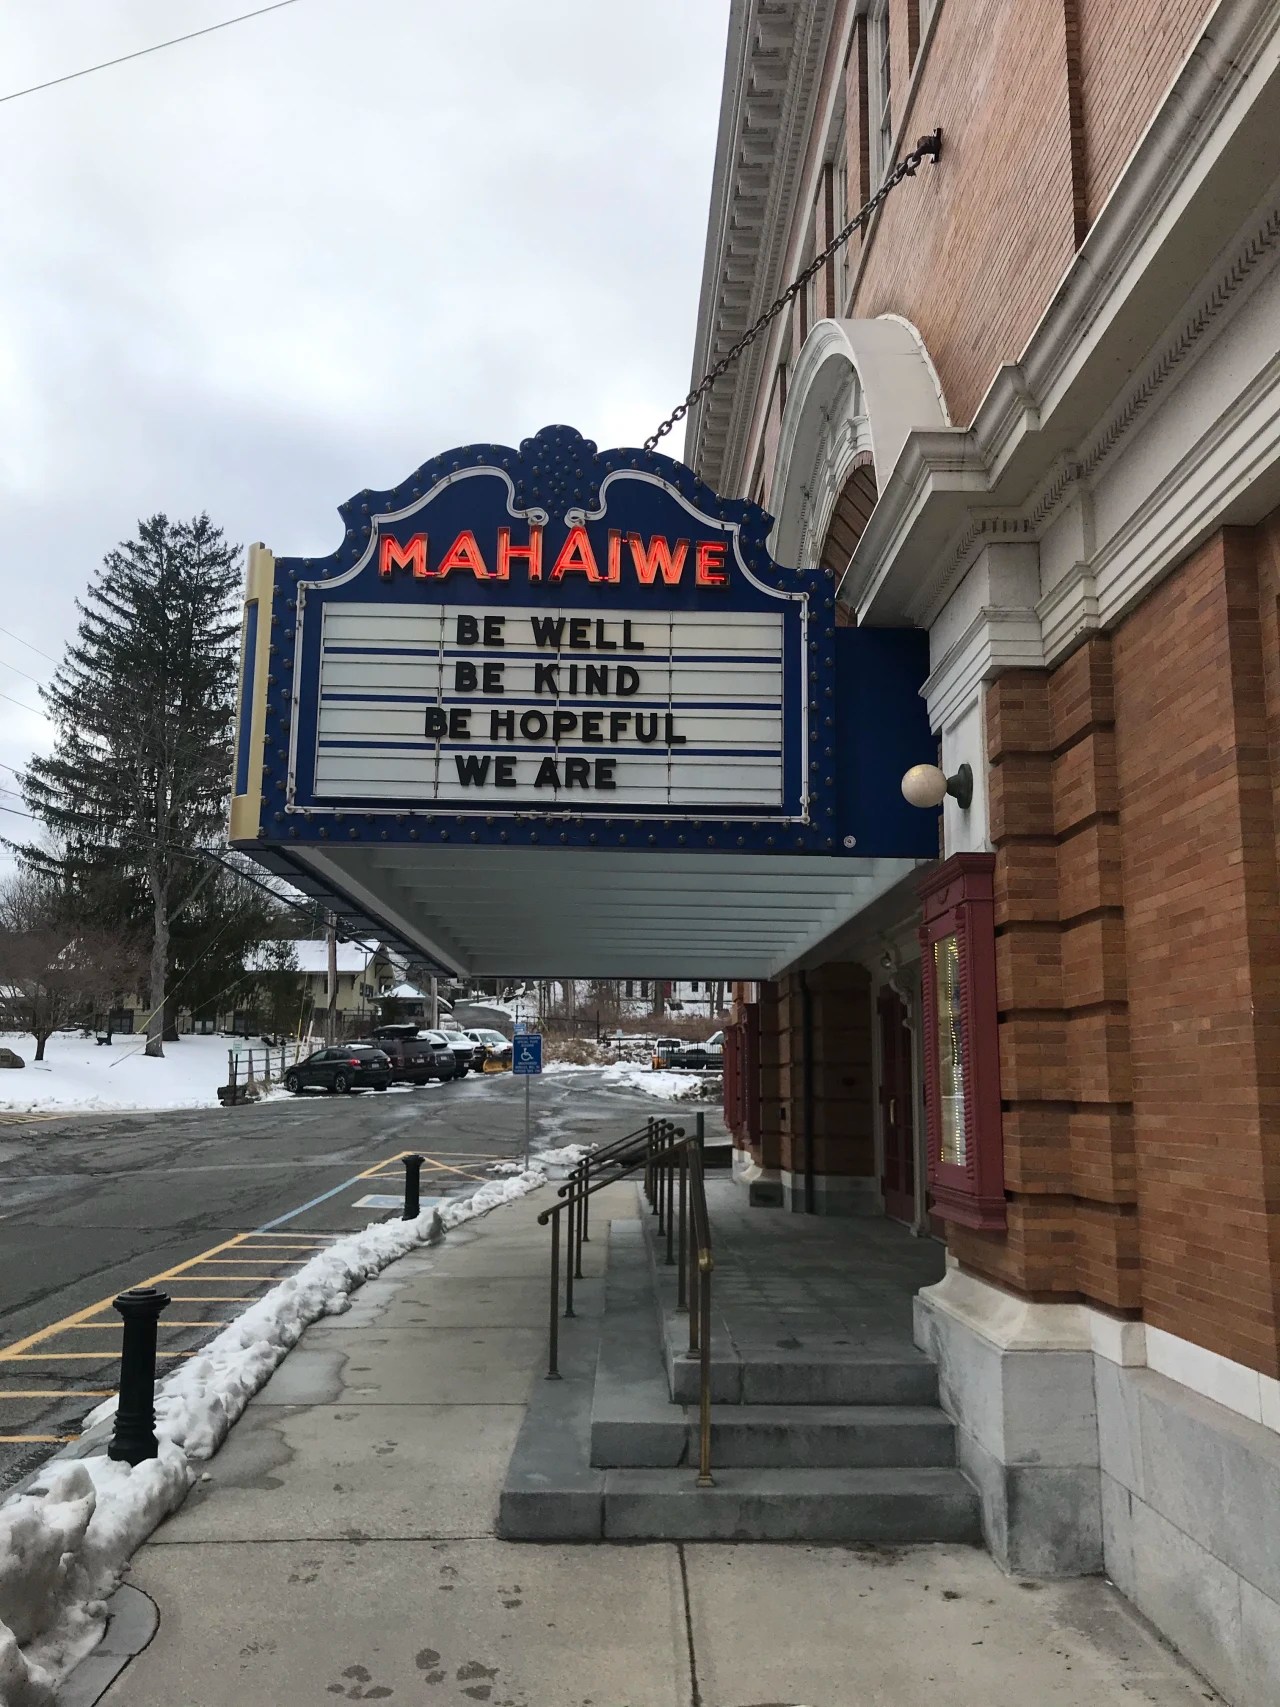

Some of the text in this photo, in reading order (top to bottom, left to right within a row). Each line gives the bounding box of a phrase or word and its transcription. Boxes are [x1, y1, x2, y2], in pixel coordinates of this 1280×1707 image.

[378, 524, 731, 587] MAHAIWE
[456, 614, 644, 650] BE WELL
[455, 661, 640, 696] BE KIND
[425, 706, 687, 744] BE HOPEFUL
[455, 755, 616, 789] WE ARE
